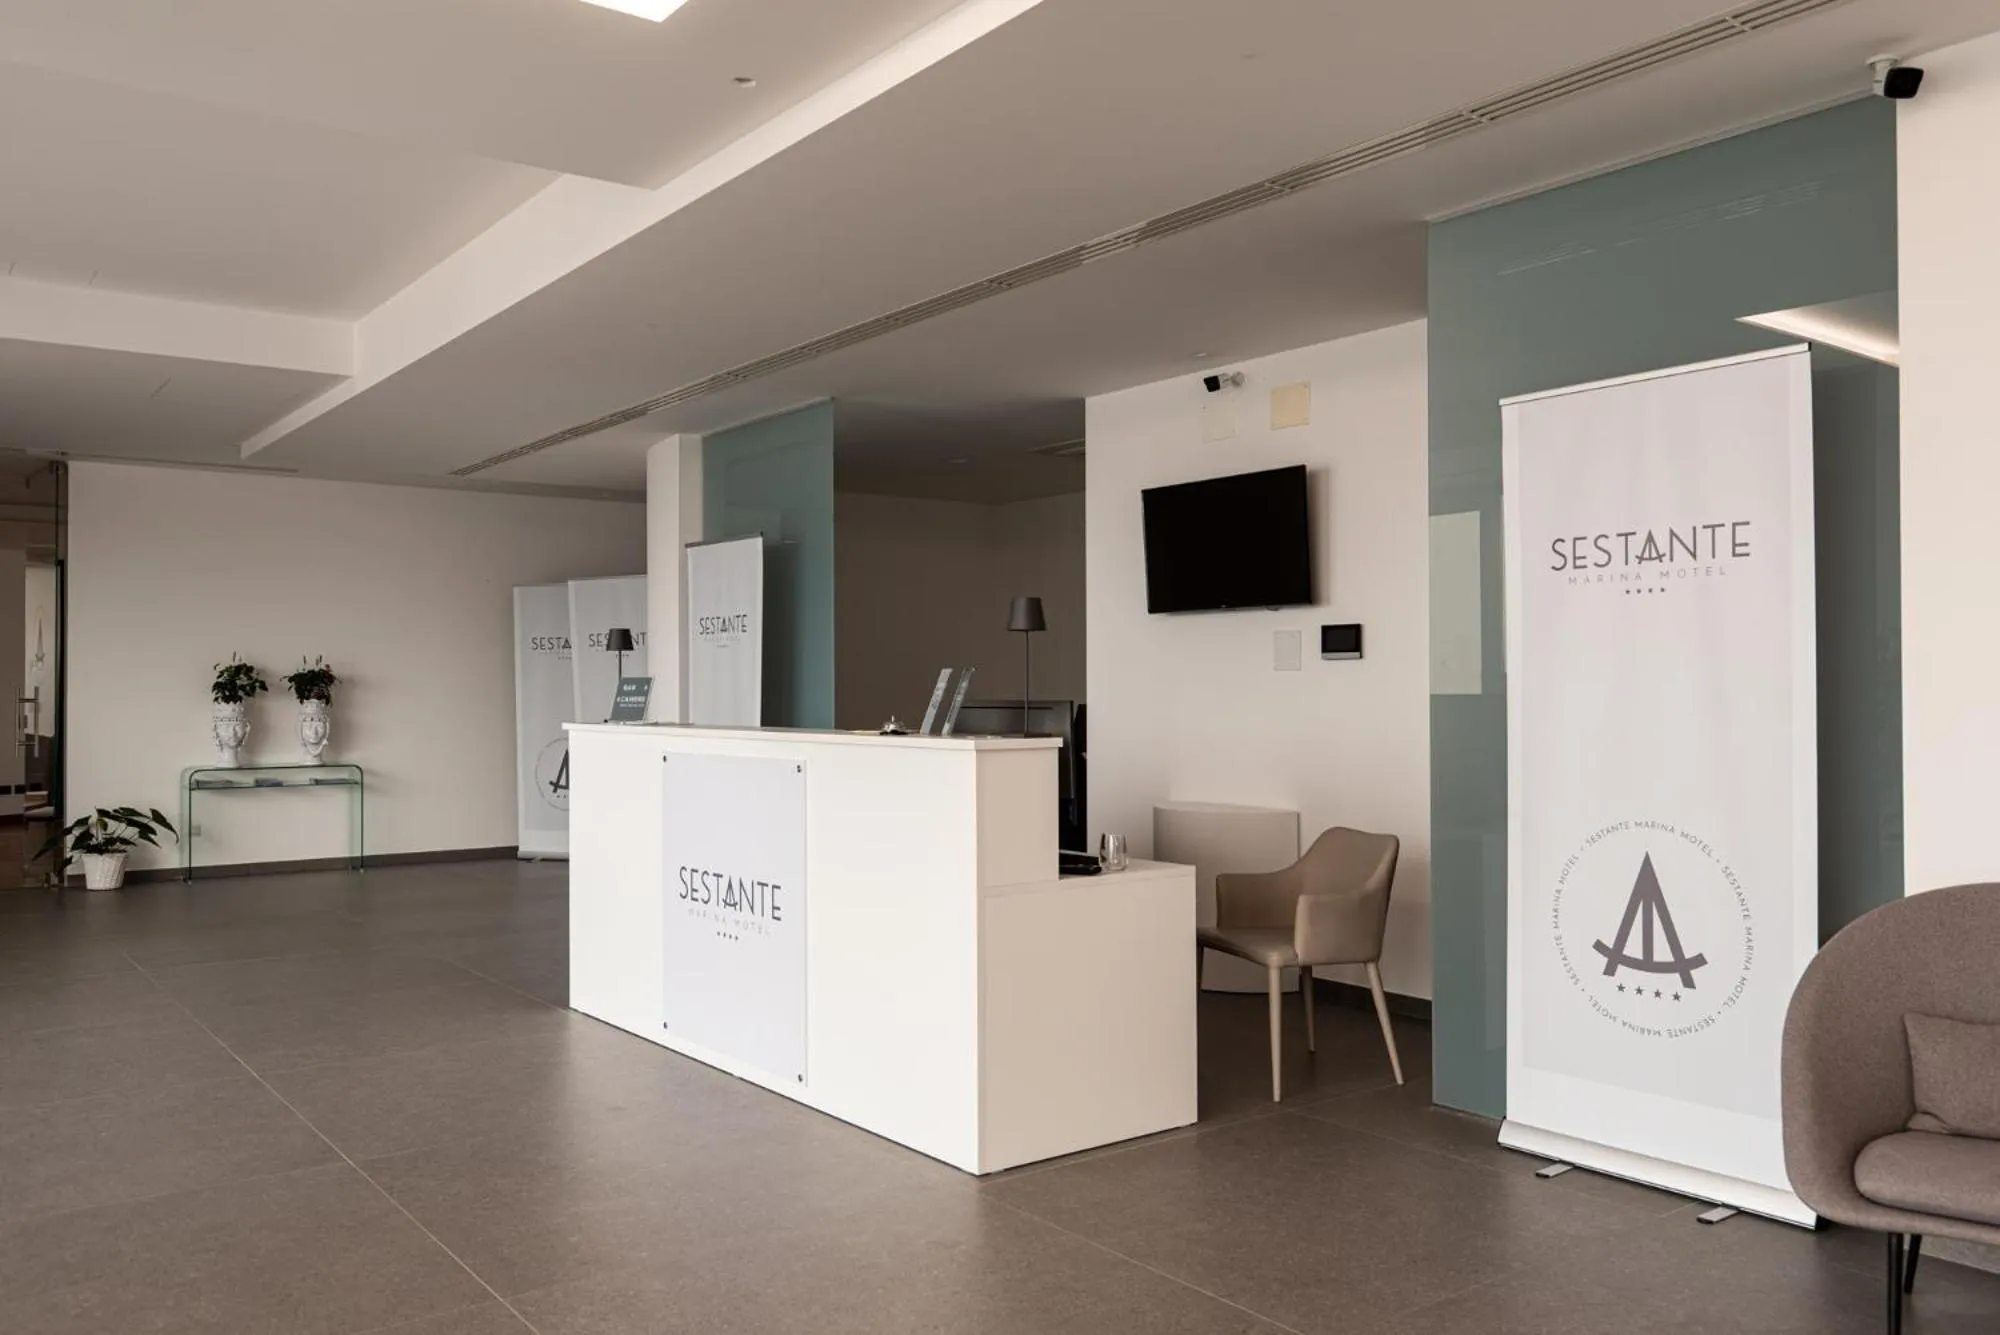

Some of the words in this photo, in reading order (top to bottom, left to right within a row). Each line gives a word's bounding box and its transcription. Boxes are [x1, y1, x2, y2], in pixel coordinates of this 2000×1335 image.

[1551, 520, 1751, 572] SESTANTE
[1568, 571, 1643, 585] MARINA
[1659, 565, 1727, 580] MOTEL
[699, 614, 748, 635] SESTANTE
[531, 636, 573, 650] SESTA
[1585, 820, 1630, 847] SESTANTE
[1634, 820, 1676, 833] MARINA
[1680, 830, 1714, 858] MOTEL
[679, 865, 782, 921] SESTANTE
[1551, 888, 1563, 930] MARINA
[1558, 854, 1580, 886] MOTEL
[1721, 865, 1751, 920] SESTANTE
[688, 907, 727, 924] MARNA
[1743, 925, 1754, 971] MARINA
[1722, 976, 1748, 1008] MOTEL
[1588, 994, 1618, 1023] MOTEL
[1621, 1019, 1662, 1037] MARINA
[1665, 1015, 1716, 1038] SESTANTE
